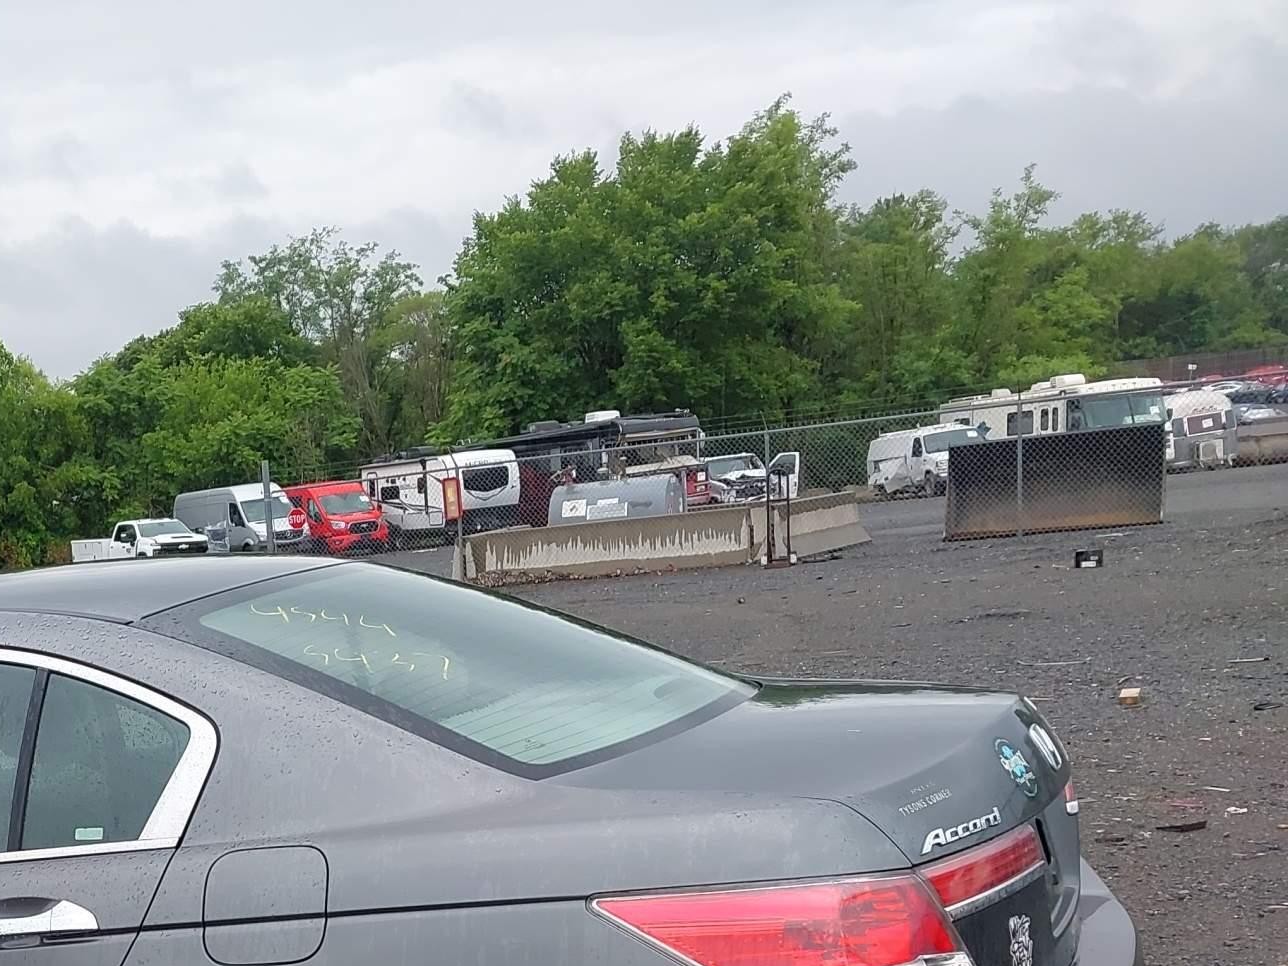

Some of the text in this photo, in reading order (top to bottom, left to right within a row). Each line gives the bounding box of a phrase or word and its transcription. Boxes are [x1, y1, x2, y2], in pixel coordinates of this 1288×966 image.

[289, 515, 305, 523] STOP
[251, 604, 396, 637] 4544
[304, 645, 448, 680] 5437
[899, 799, 928, 816] TYSONS
[920, 806, 1002, 855] Accord
